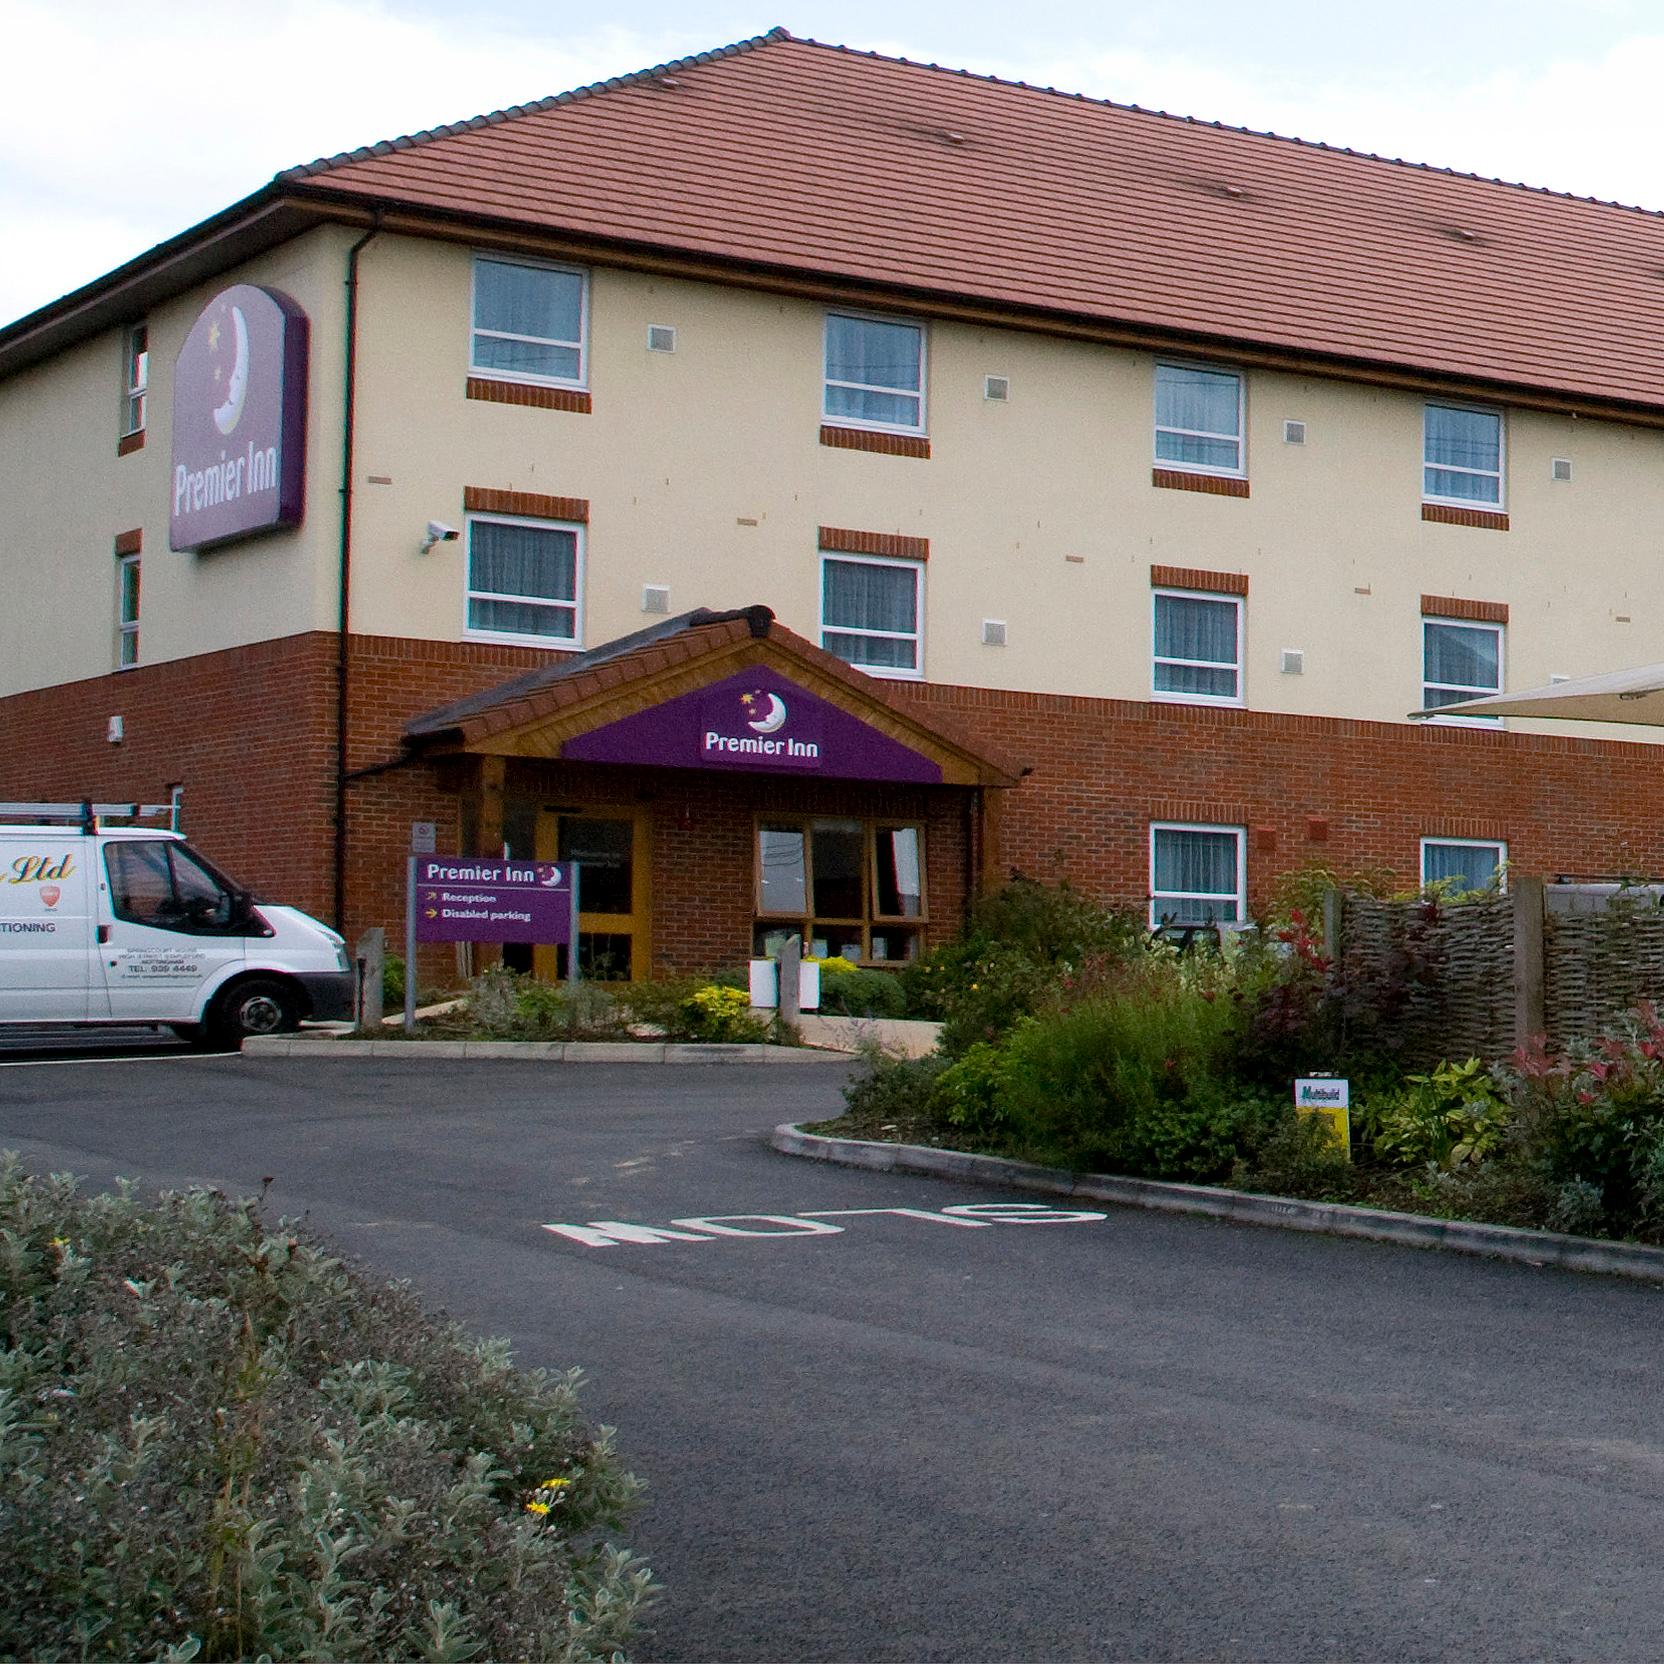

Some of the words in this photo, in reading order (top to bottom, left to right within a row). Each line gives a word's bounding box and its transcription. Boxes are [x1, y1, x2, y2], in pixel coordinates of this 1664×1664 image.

[175, 449, 246, 516] Premier
[247, 440, 277, 495] Inn
[705, 731, 785, 755] Premier
[787, 738, 818, 757] Inn
[8, 853, 77, 884] Ltd
[427, 864, 502, 881] Premier
[505, 866, 535, 882] Inn
[441, 892, 497, 903] Reception
[442, 908, 489, 920] Disabled
[490, 910, 531, 922] parking
[541, 1202, 1109, 1248] SLOW
